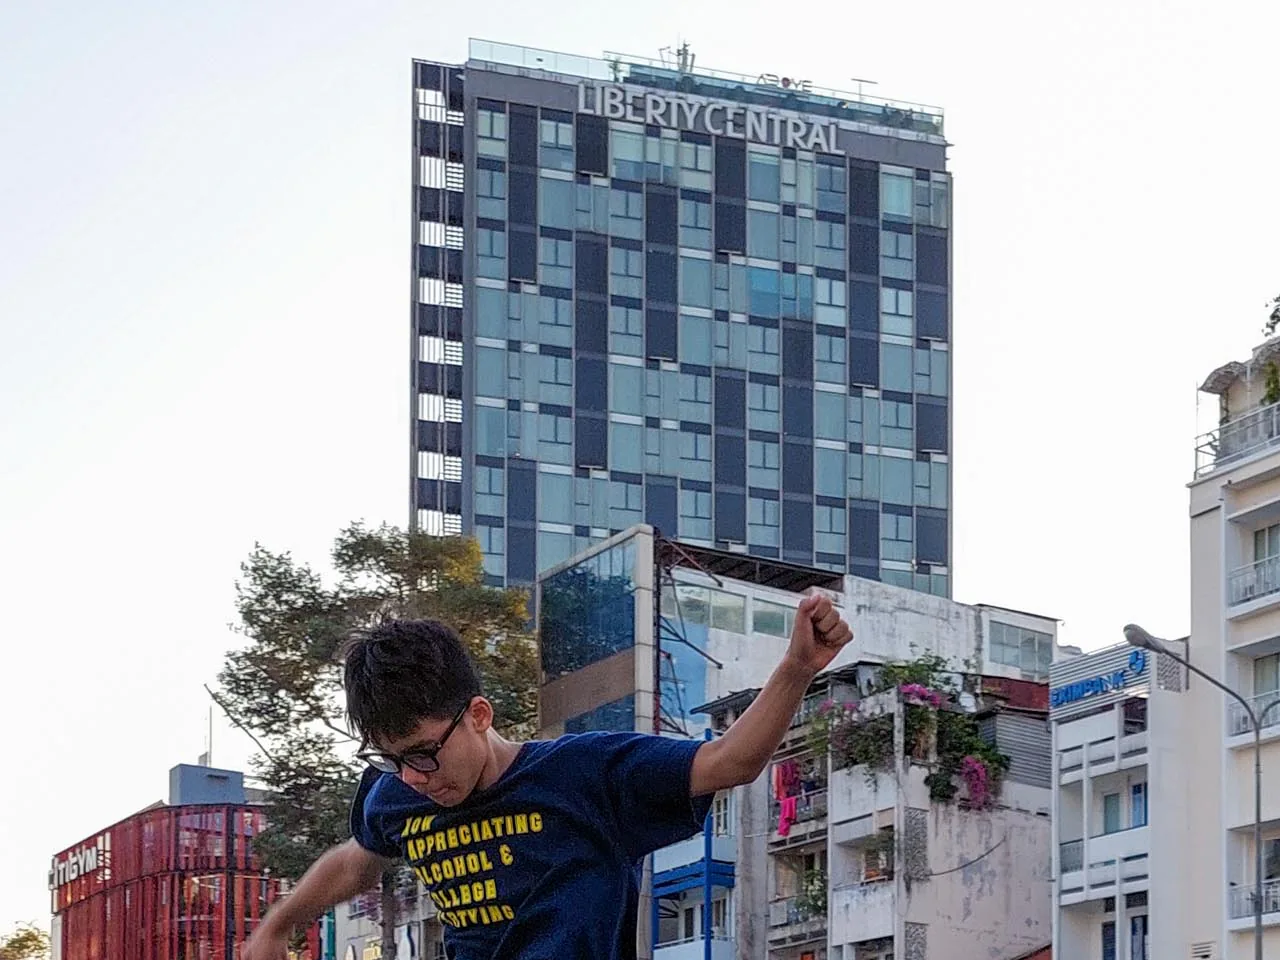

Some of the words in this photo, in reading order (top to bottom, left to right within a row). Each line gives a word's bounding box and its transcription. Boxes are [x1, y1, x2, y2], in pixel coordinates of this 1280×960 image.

[407, 811, 544, 861] APPRECIATING
[499, 843, 514, 867] &
[430, 878, 498, 909] OLLEGE
